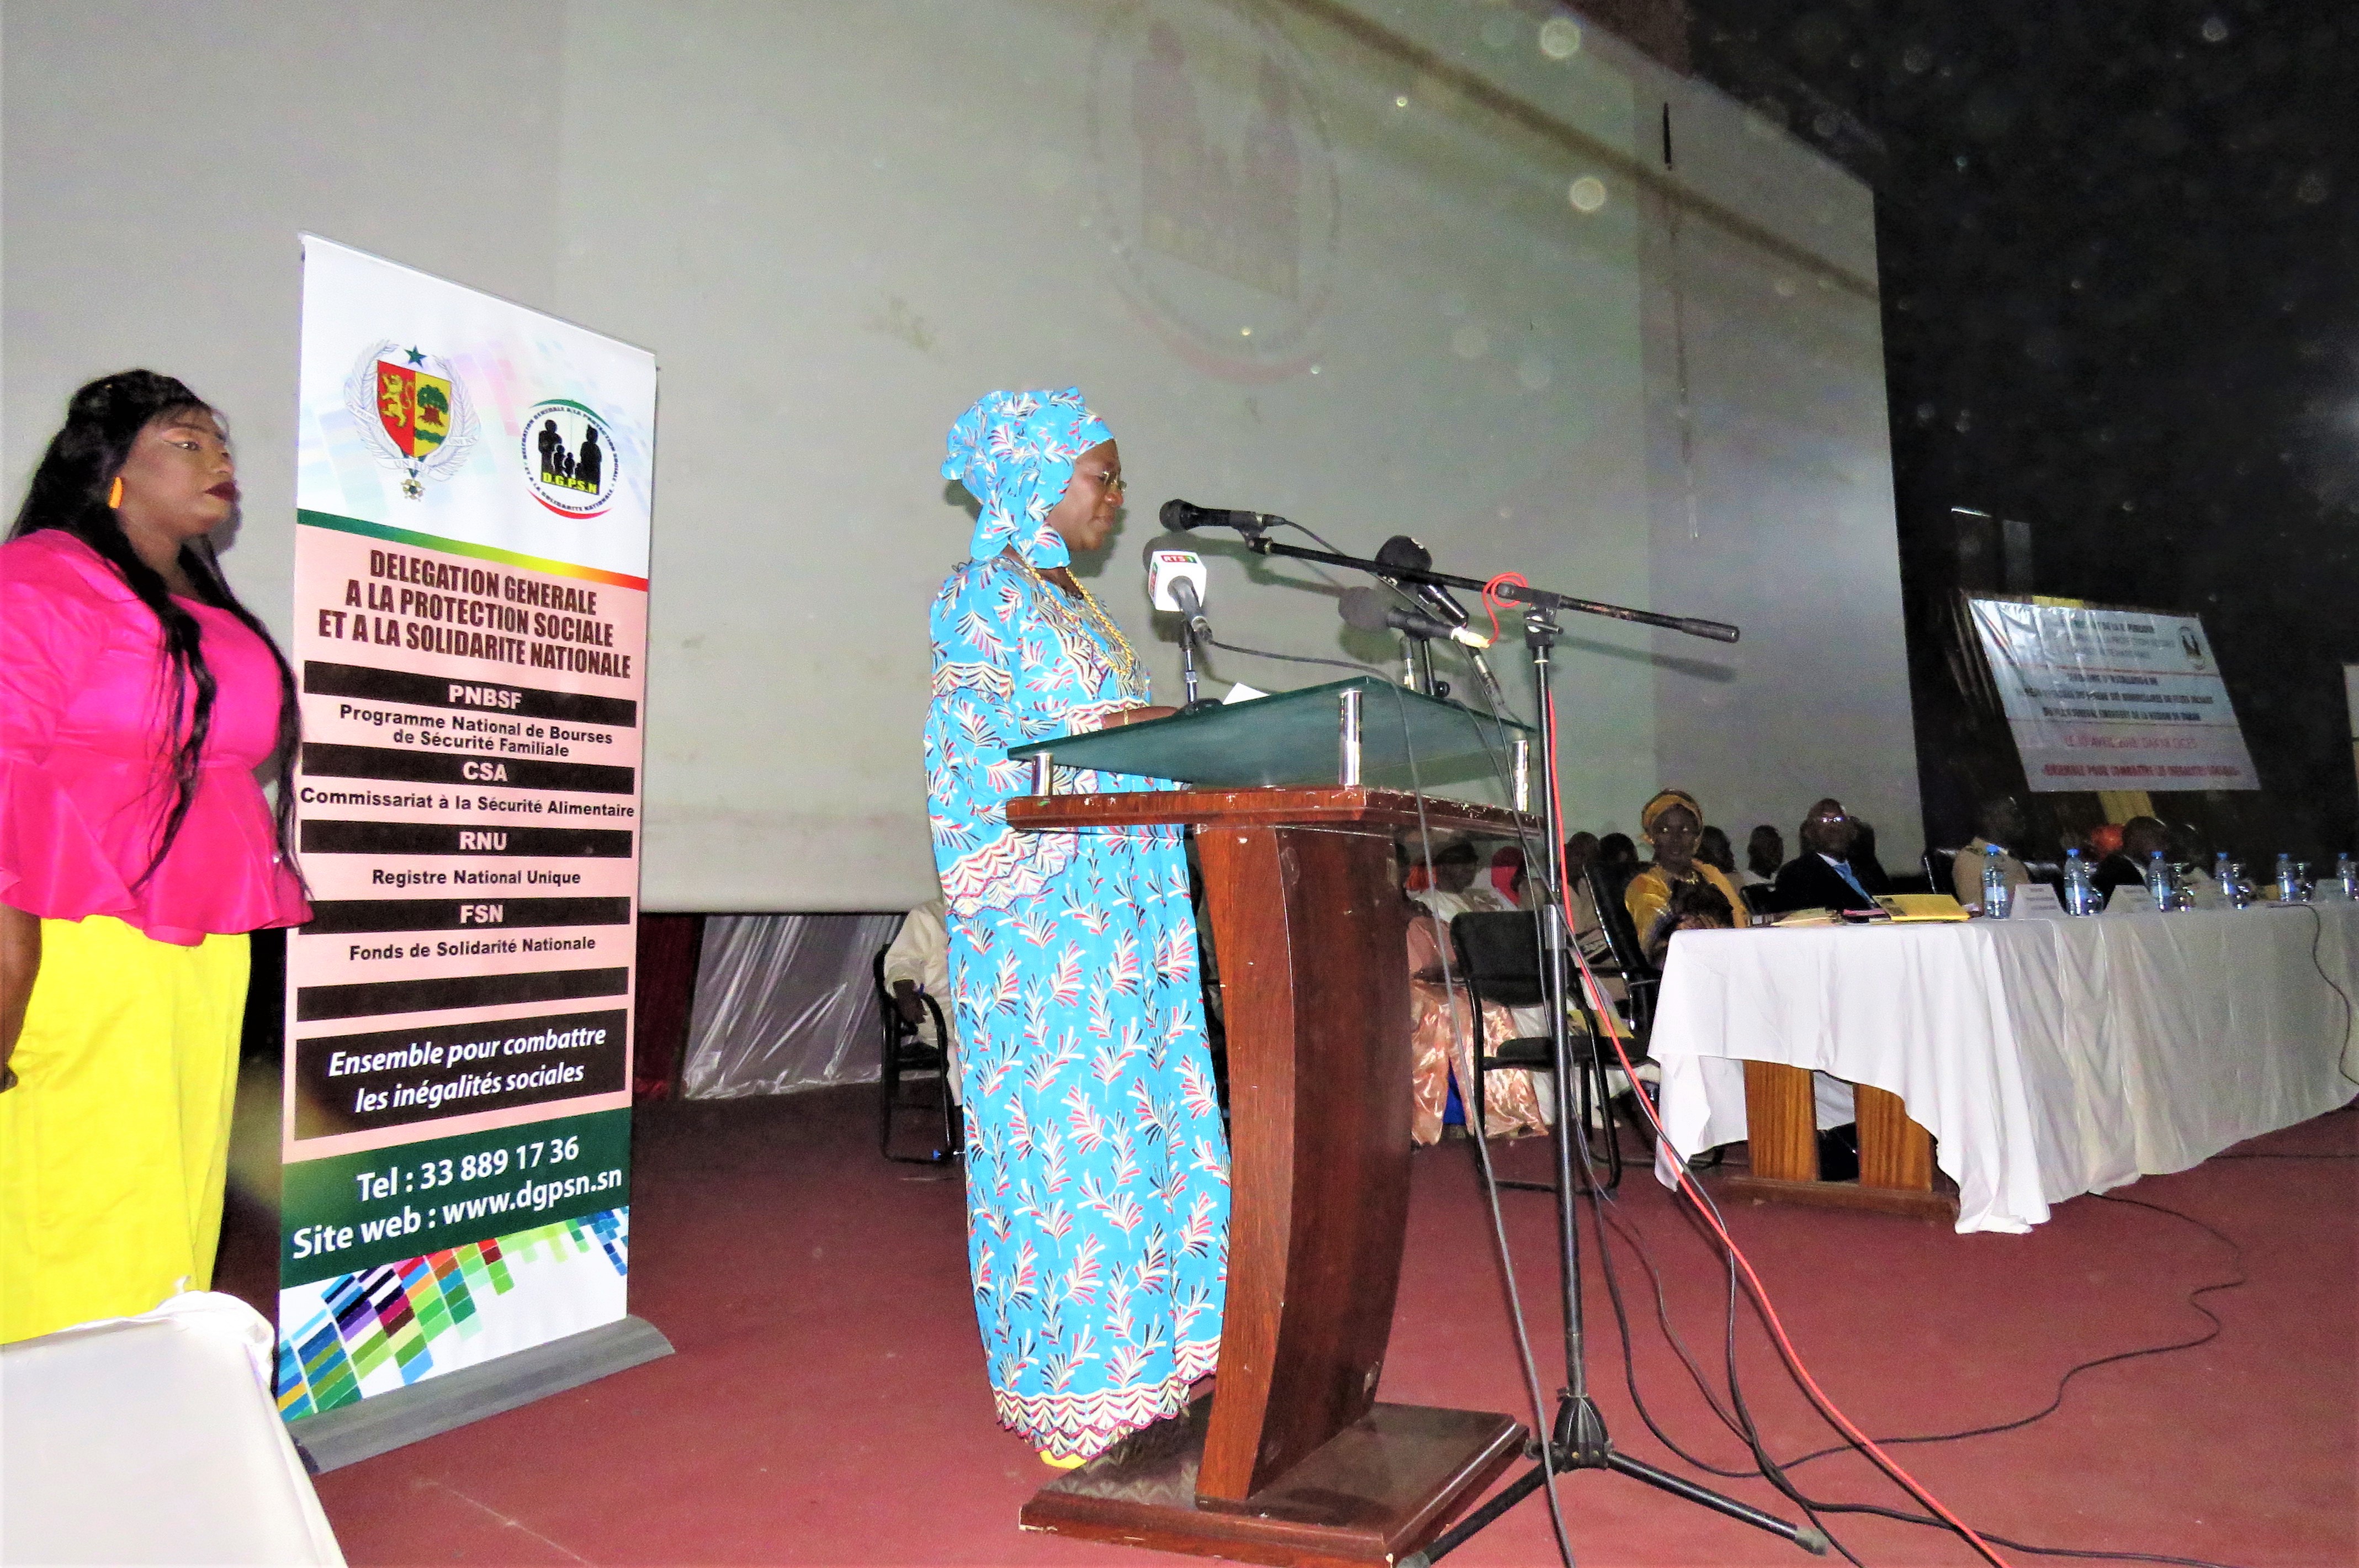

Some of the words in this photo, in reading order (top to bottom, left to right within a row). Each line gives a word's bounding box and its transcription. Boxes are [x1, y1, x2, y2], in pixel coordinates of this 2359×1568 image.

[370, 549, 499, 598] DELEGATION
[505, 576, 597, 616] GENERALE
[345, 579, 362, 608] A
[368, 582, 395, 613] LA
[401, 589, 529, 635] PROTECTION
[534, 615, 614, 648] SOCIALE
[318, 609, 347, 638] ET
[352, 614, 368, 643] A
[374, 617, 400, 648] LA
[406, 622, 526, 665] SOLIDARITE
[530, 642, 631, 679] NATIONALE
[448, 685, 522, 710] PNBSF
[340, 704, 446, 729] Programme
[452, 716, 521, 737] National
[526, 723, 544, 739] de
[550, 725, 613, 745] Bourses
[394, 728, 415, 745] de
[421, 730, 495, 751] Sécurité
[500, 738, 569, 757] Familiale
[462, 761, 508, 782] CSA
[300, 788, 433, 809] Commissariat
[439, 794, 450, 809] à
[455, 794, 471, 811] la
[477, 796, 542, 814] Sécurité
[547, 799, 634, 818] Alimentaire
[459, 831, 507, 850] RNU
[372, 869, 447, 888] Registre
[453, 870, 522, 884] National
[527, 871, 581, 888] Unique
[460, 904, 504, 924] FSN
[349, 944, 404, 961] Fonds
[409, 942, 431, 958] de
[437, 939, 516, 956] Solidarité
[522, 937, 596, 953] Nationale
[328, 1042, 444, 1078] Ensemble
[446, 1039, 501, 1069] pour
[503, 1027, 607, 1056] combattre
[354, 1088, 388, 1114] les
[393, 1072, 502, 1110] inégalités
[505, 1061, 586, 1092] sociales
[420, 1159, 454, 1190] 33
[460, 1148, 508, 1182] 889
[515, 1142, 544, 1171] 17
[549, 1135, 579, 1164] 36
[292, 1223, 353, 1259] Site
[361, 1205, 421, 1243] web
[442, 1168, 623, 1226] www.dgpsn.sn
